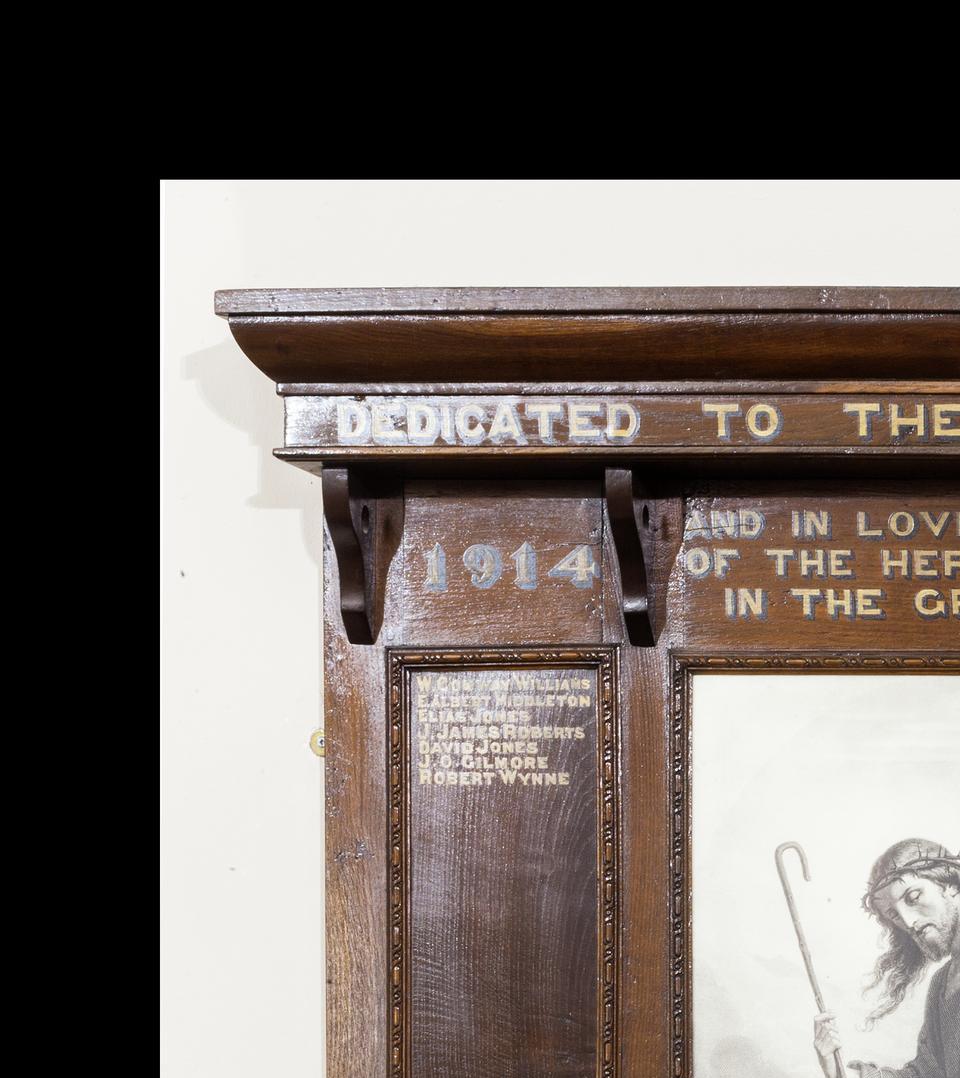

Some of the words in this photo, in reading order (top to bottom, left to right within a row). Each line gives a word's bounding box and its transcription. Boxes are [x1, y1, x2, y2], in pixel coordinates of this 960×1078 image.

[337, 402, 641, 445] DEDICATED
[702, 403, 784, 441] TO
[684, 509, 766, 540] AND
[792, 510, 832, 540] IN
[423, 541, 600, 592] 1914
[684, 548, 740, 578] OF
[764, 549, 854, 580] THE
[724, 588, 767, 621] IN
[791, 589, 886, 621] THE
[513, 674, 591, 690] WILLIAMS
[470, 710, 531, 724] JONES
[437, 723, 500, 739] JAMES
[503, 723, 586, 739] ROBERTS
[419, 741, 474, 755] DAVID
[476, 740, 538, 755] JONES
[462, 755, 549, 769] GILMORE
[419, 768, 495, 785] ROBERT
[497, 768, 570, 785] WYNNE
